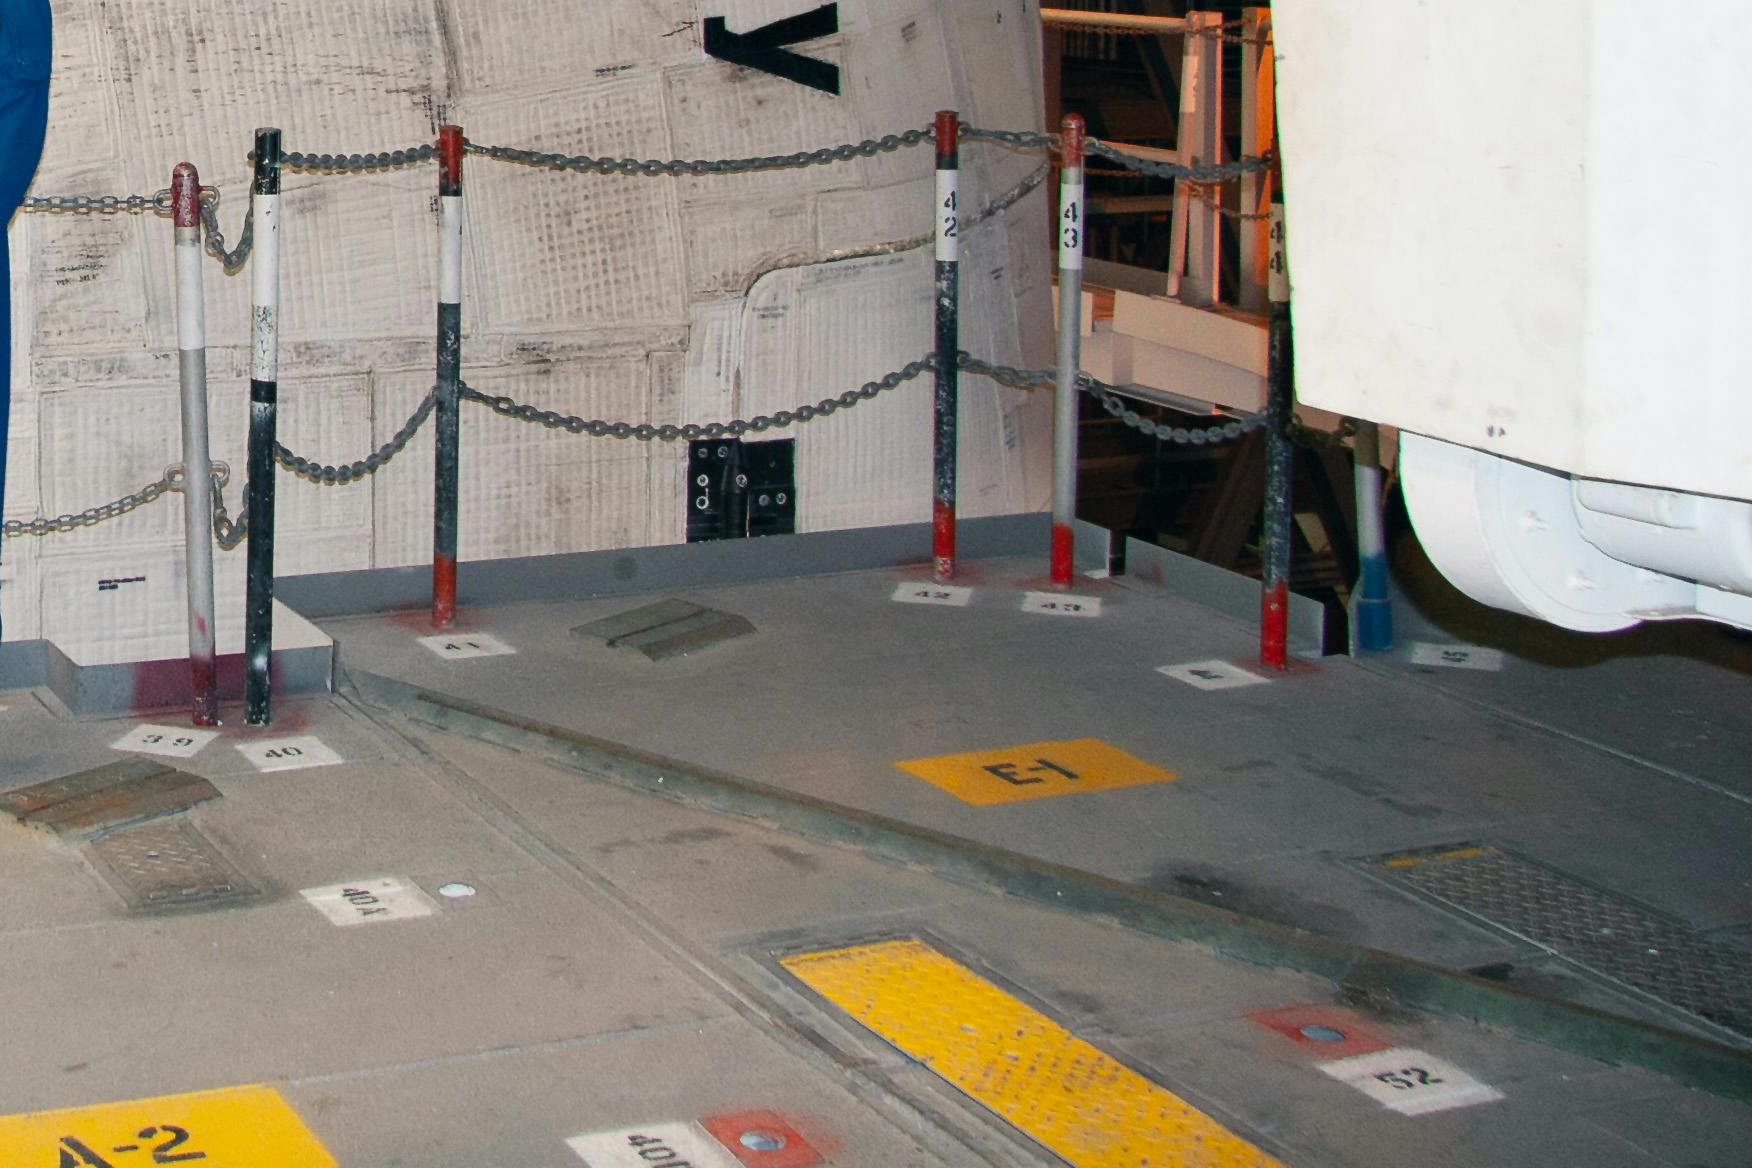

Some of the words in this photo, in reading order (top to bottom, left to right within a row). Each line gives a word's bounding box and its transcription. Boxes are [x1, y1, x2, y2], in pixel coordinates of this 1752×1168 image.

[943, 190, 958, 238] 42
[1063, 201, 1079, 249] 43
[1270, 220, 1284, 274] 44
[444, 641, 481, 651] 41
[141, 733, 195, 748] 39
[265, 745, 304, 759] 40
[981, 757, 1081, 786] E-1
[342, 887, 388, 916] 40A
[1372, 1066, 1446, 1090] 52
[59, 1124, 207, 1168] A-2
[627, 1134, 694, 1168] 40
